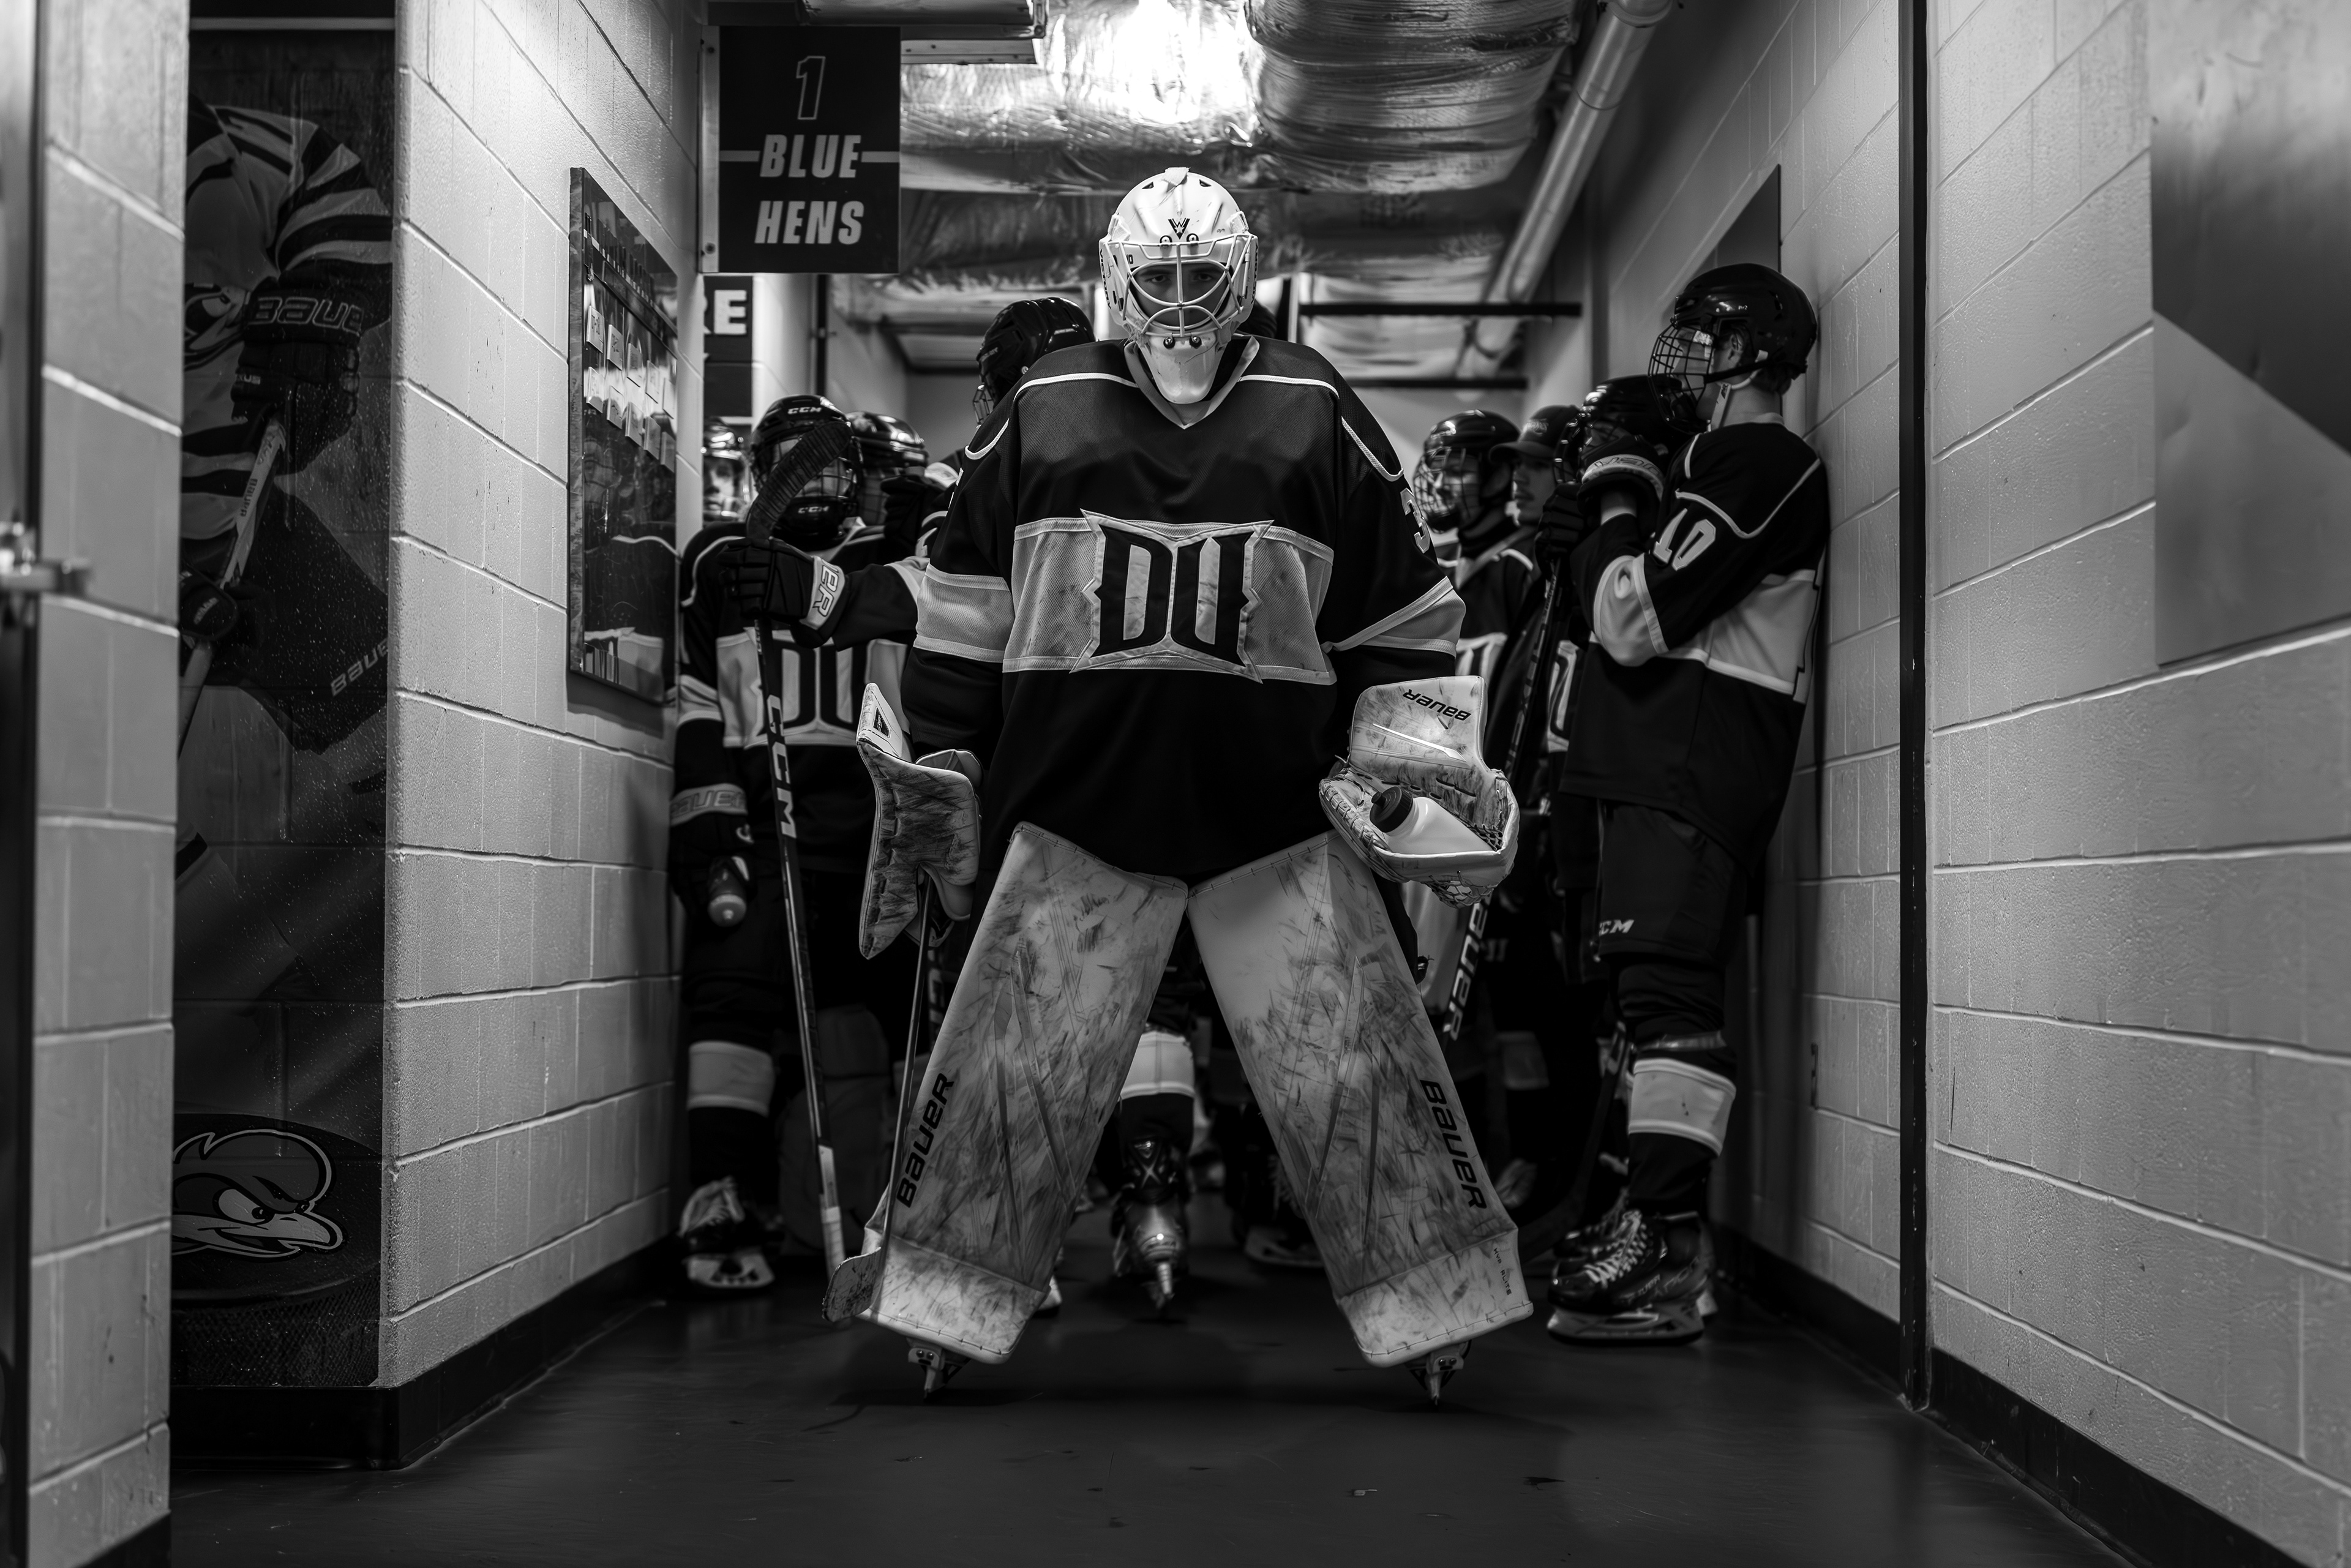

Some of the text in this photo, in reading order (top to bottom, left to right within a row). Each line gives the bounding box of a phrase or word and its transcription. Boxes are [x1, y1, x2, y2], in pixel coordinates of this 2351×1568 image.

[796, 55, 826, 121] 1
[759, 134, 861, 178] BLUE
[754, 200, 864, 245] HENS
[704, 289, 748, 336] E
[787, 407, 823, 415] CCM
[1652, 508, 1717, 572] 10
[812, 558, 839, 617] ER
[1089, 520, 1258, 669] DU
[331, 637, 388, 697] BAUE
[1403, 689, 1472, 721] BAUER
[766, 694, 797, 839] CCM
[1599, 919, 1635, 937] CM
[896, 1073, 955, 1209] BAUER
[1419, 1079, 1488, 1210] BAUER
